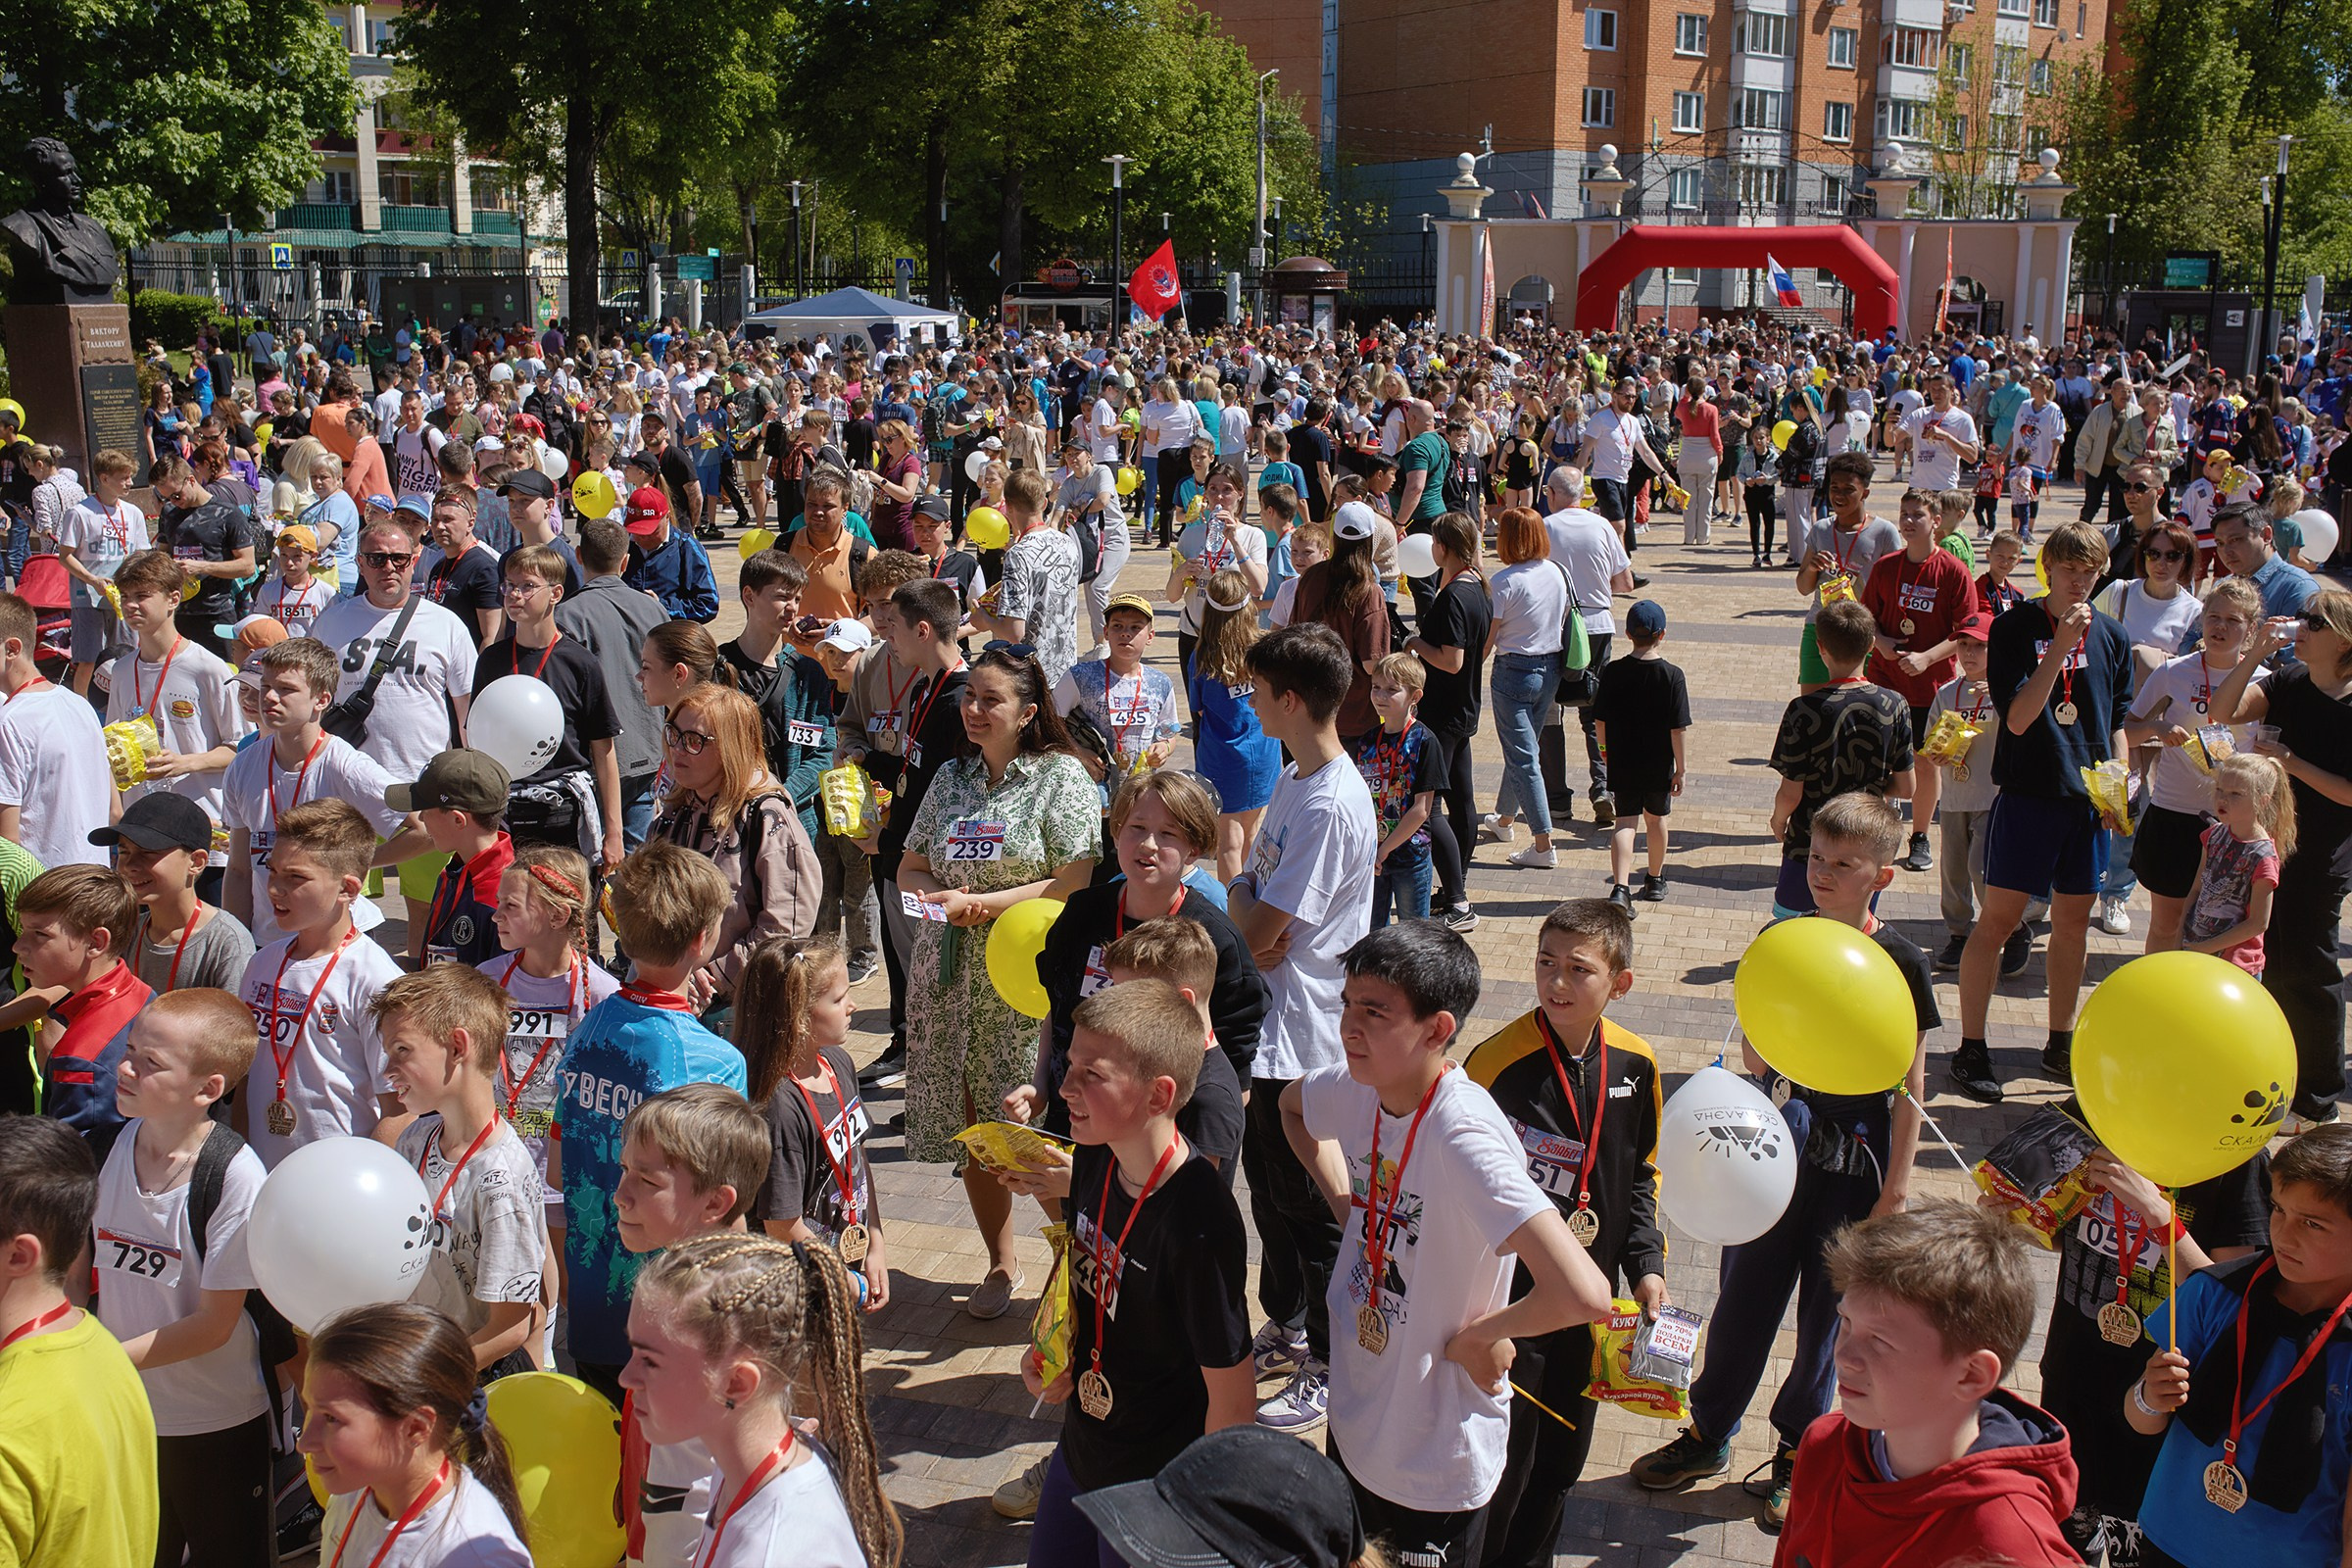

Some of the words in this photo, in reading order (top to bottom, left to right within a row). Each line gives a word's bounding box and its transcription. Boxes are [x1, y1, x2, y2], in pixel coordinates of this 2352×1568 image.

[86, 340, 125, 349] ТАЛАЛИХИНУ
[1902, 596, 1930, 611] 660
[1961, 709, 1987, 721] 954
[953, 840, 995, 859] 239
[509, 1010, 553, 1035] 991
[1609, 1086, 1632, 1099] PUMA
[1692, 1110, 1779, 1126] СКААЛЭНД
[1548, 1144, 1583, 1160] ЗАБЕГ
[1528, 1156, 1562, 1190] 51
[2086, 1217, 2151, 1266] 052
[113, 1242, 167, 1278] 729
[1680, 1308, 1701, 1323] АГАТ
[1656, 1328, 1692, 1344] ПОДАРКИ
[1660, 1322, 1674, 1334] до
[1675, 1324, 1693, 1337] 70%
[1653, 1335, 1691, 1354] ВСЕМ
[1642, 1391, 1665, 1401] пудре
[2216, 1495, 2237, 1513] ЗАБЕГ
[1401, 1550, 1441, 1568] PUMA
